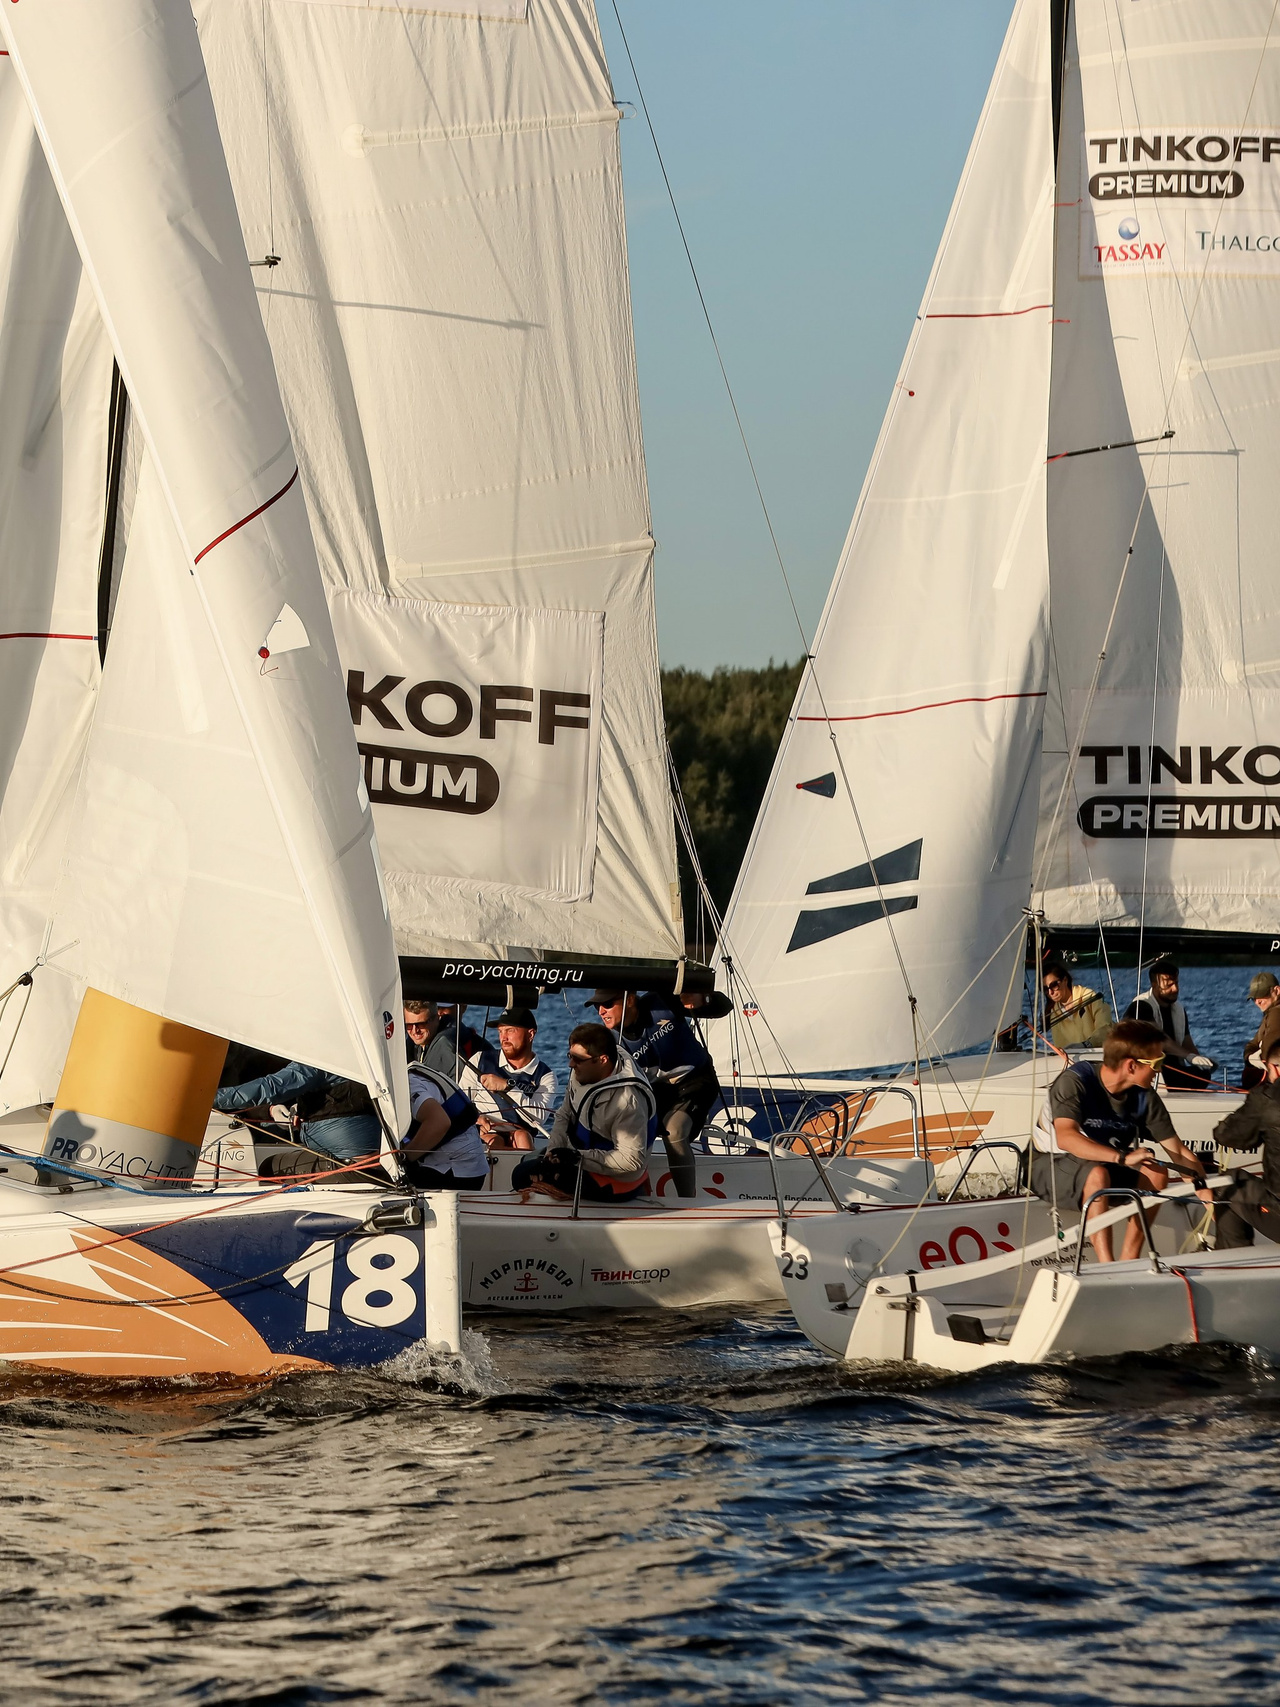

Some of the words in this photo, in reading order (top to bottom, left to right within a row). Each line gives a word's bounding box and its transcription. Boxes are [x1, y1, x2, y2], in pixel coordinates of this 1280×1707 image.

[1098, 174, 1234, 196] PREMIUM
[1094, 243, 1166, 263] TASSAY
[442, 963, 584, 984] pro-yachting.ru
[480, 1258, 574, 1289] МОРПРИБОР
[781, 1252, 808, 1280] 23
[282, 1233, 420, 1333] 18
